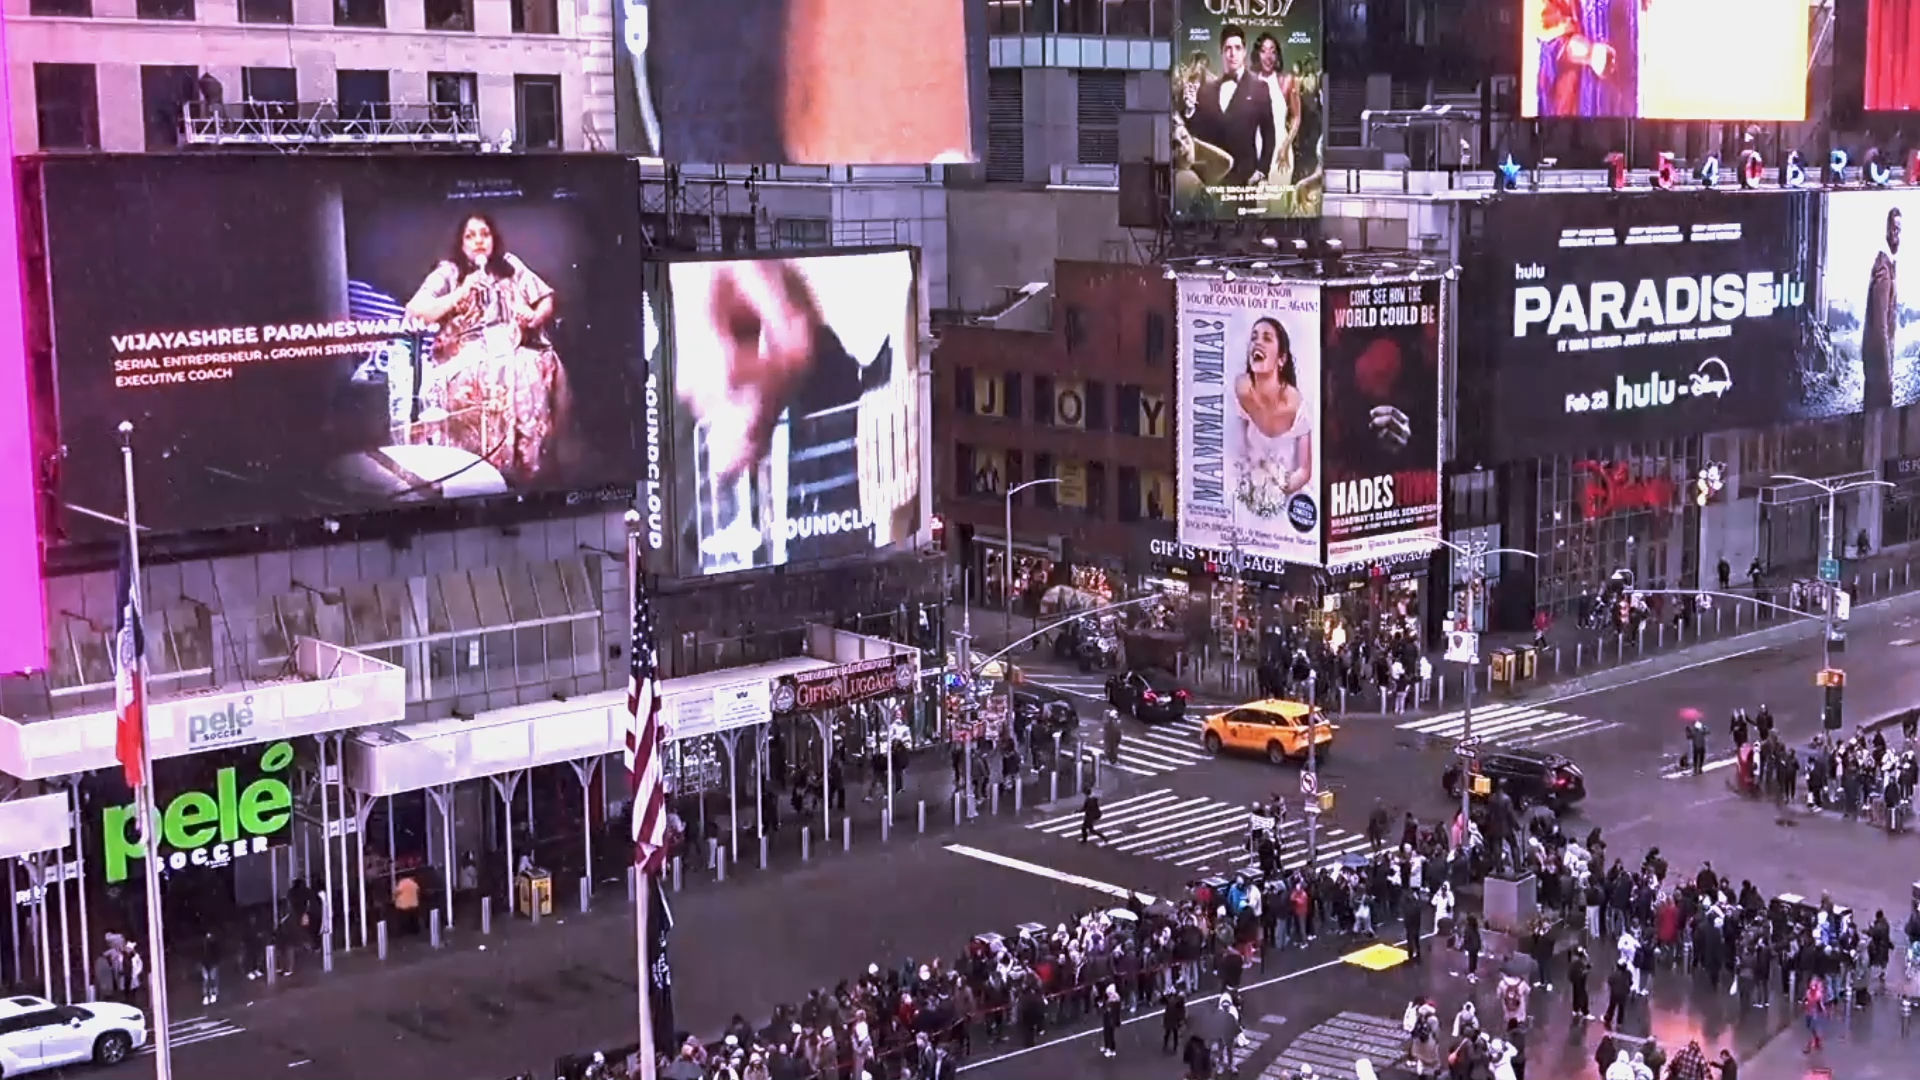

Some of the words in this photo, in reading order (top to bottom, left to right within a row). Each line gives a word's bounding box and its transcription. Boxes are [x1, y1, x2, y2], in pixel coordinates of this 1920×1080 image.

[1516, 263, 1545, 279] hulu
[1209, 283, 1225, 294] YOU
[1228, 283, 1265, 296] ALREADY
[1267, 286, 1292, 298] KNOW
[1217, 295, 1246, 308] GONNA
[1350, 289, 1371, 306] COME
[1373, 287, 1388, 304] SEE
[1389, 287, 1406, 303] HOW
[1408, 285, 1422, 302] THE
[1334, 307, 1378, 328] WORLD
[1380, 304, 1419, 326] COULD
[1421, 304, 1436, 324] BE
[1514, 271, 1774, 337] PARADISE
[111, 327, 260, 353] VIJAYASHREE
[1193, 318, 1224, 385] MIA!
[114, 358, 160, 371] SERIAL
[163, 350, 263, 369] ENTREPRENEUR
[270, 345, 323, 360] GROWTH
[116, 371, 185, 387] EXECUTIVE
[188, 367, 233, 381] COACH
[1615, 371, 1676, 410] hulu
[1193, 394, 1224, 504] MAMMA
[1150, 539, 1196, 560] GIFTS
[797, 684, 831, 706] GIFTS
[843, 671, 896, 698] LUGGAGE
[188, 695, 254, 743] pelé
[203, 729, 243, 742] SOCCER
[103, 742, 294, 882] pelé
[156, 836, 268, 873] SOCCER
